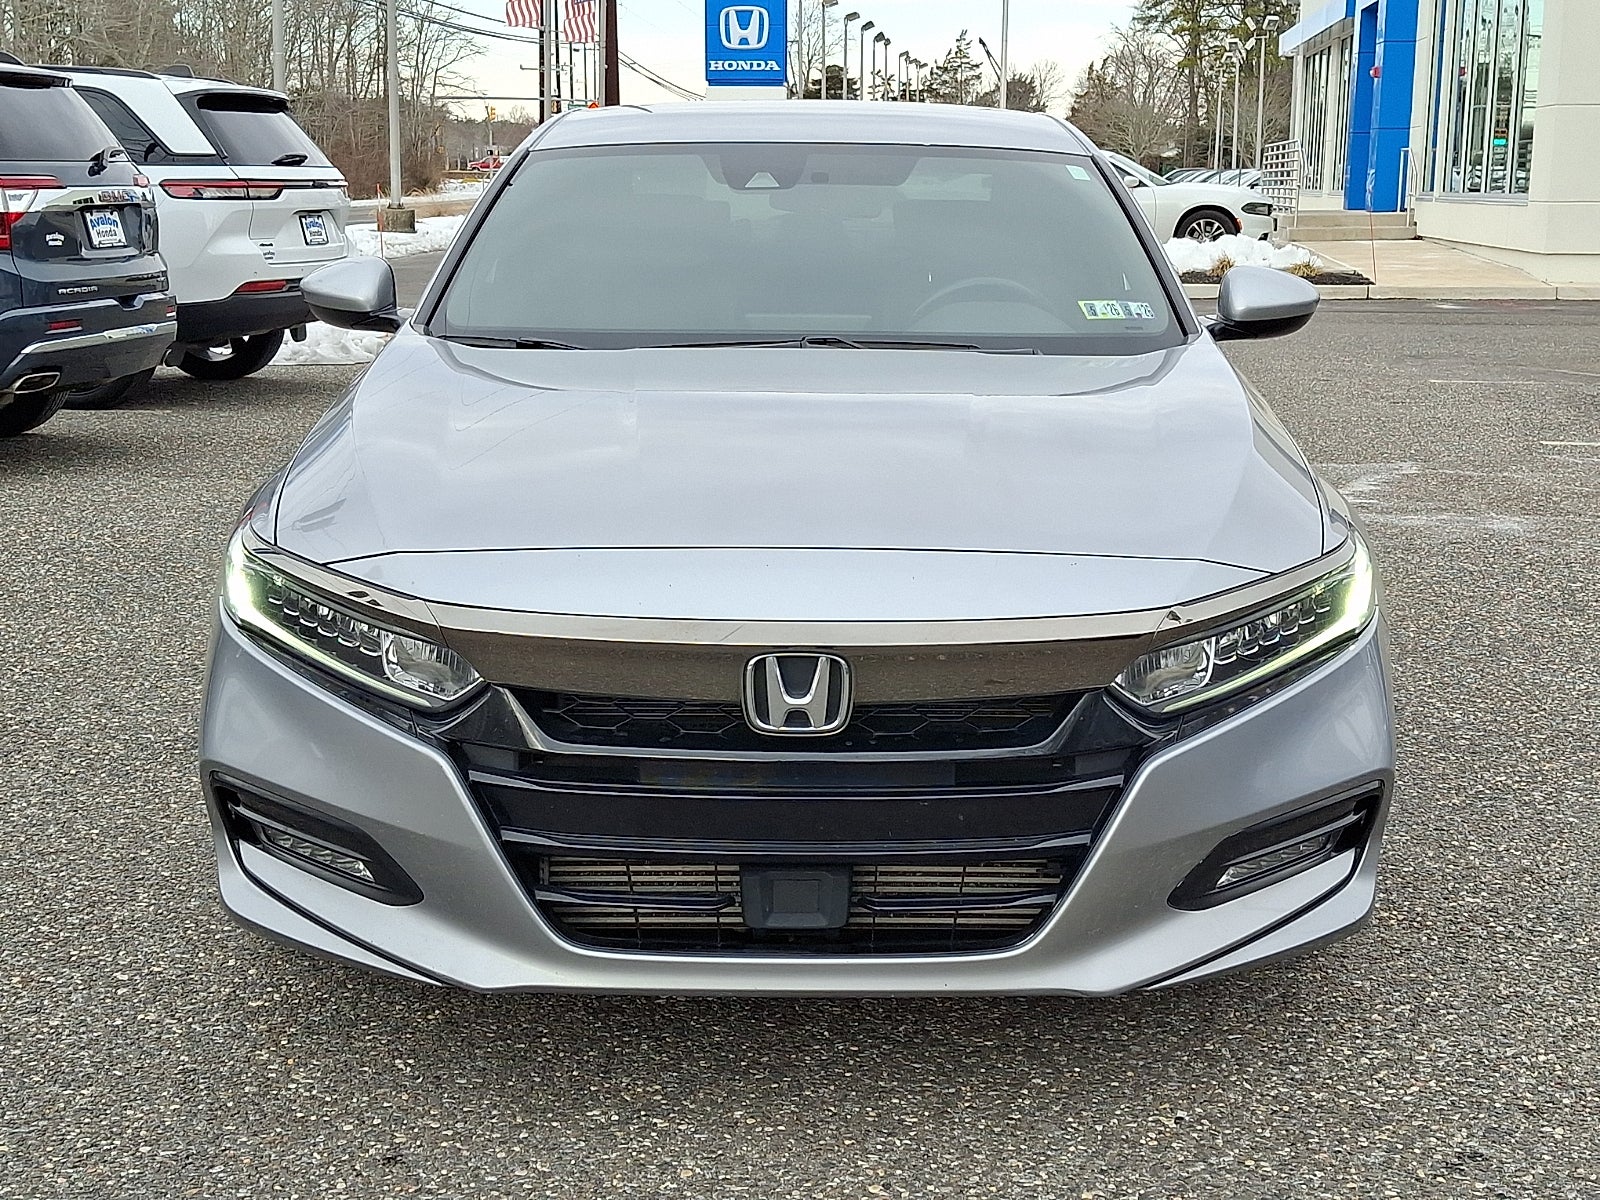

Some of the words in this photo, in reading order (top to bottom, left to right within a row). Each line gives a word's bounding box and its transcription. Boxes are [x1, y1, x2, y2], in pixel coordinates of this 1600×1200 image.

[709, 60, 780, 71] HONDA
[89, 213, 119, 230] Avalon
[96, 226, 117, 238] Honda
[57, 285, 98, 295] ACADIA
